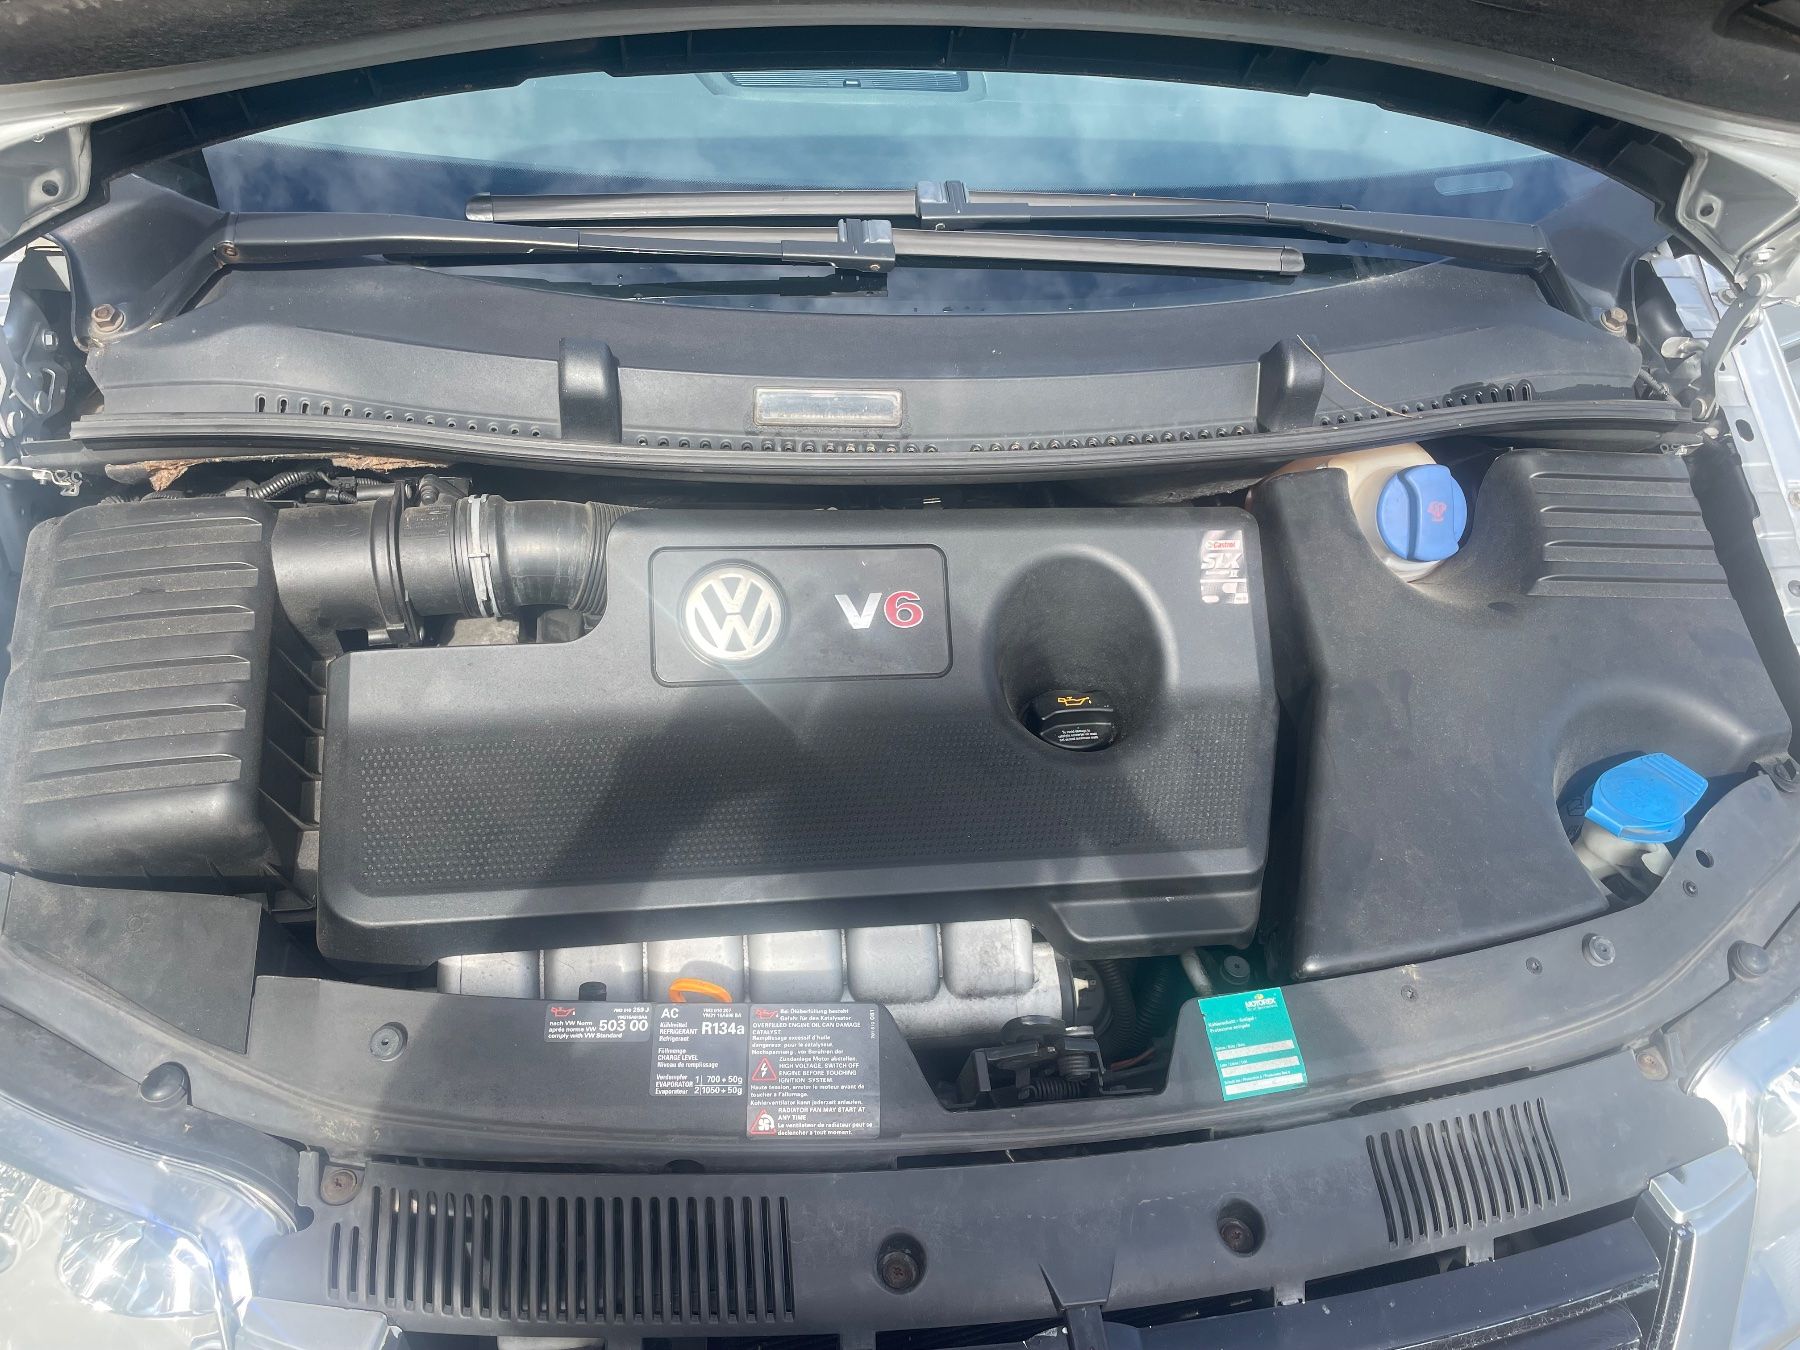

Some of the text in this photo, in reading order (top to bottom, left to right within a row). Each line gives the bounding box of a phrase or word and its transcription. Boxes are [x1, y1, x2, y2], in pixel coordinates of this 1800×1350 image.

[835, 590, 924, 629] V6
[661, 1008, 679, 1018] AC
[599, 1020, 648, 1031] 503 00
[702, 1022, 745, 1035] R134a
[728, 1076, 742, 1084] 50g
[728, 1087, 742, 1095] 50g
